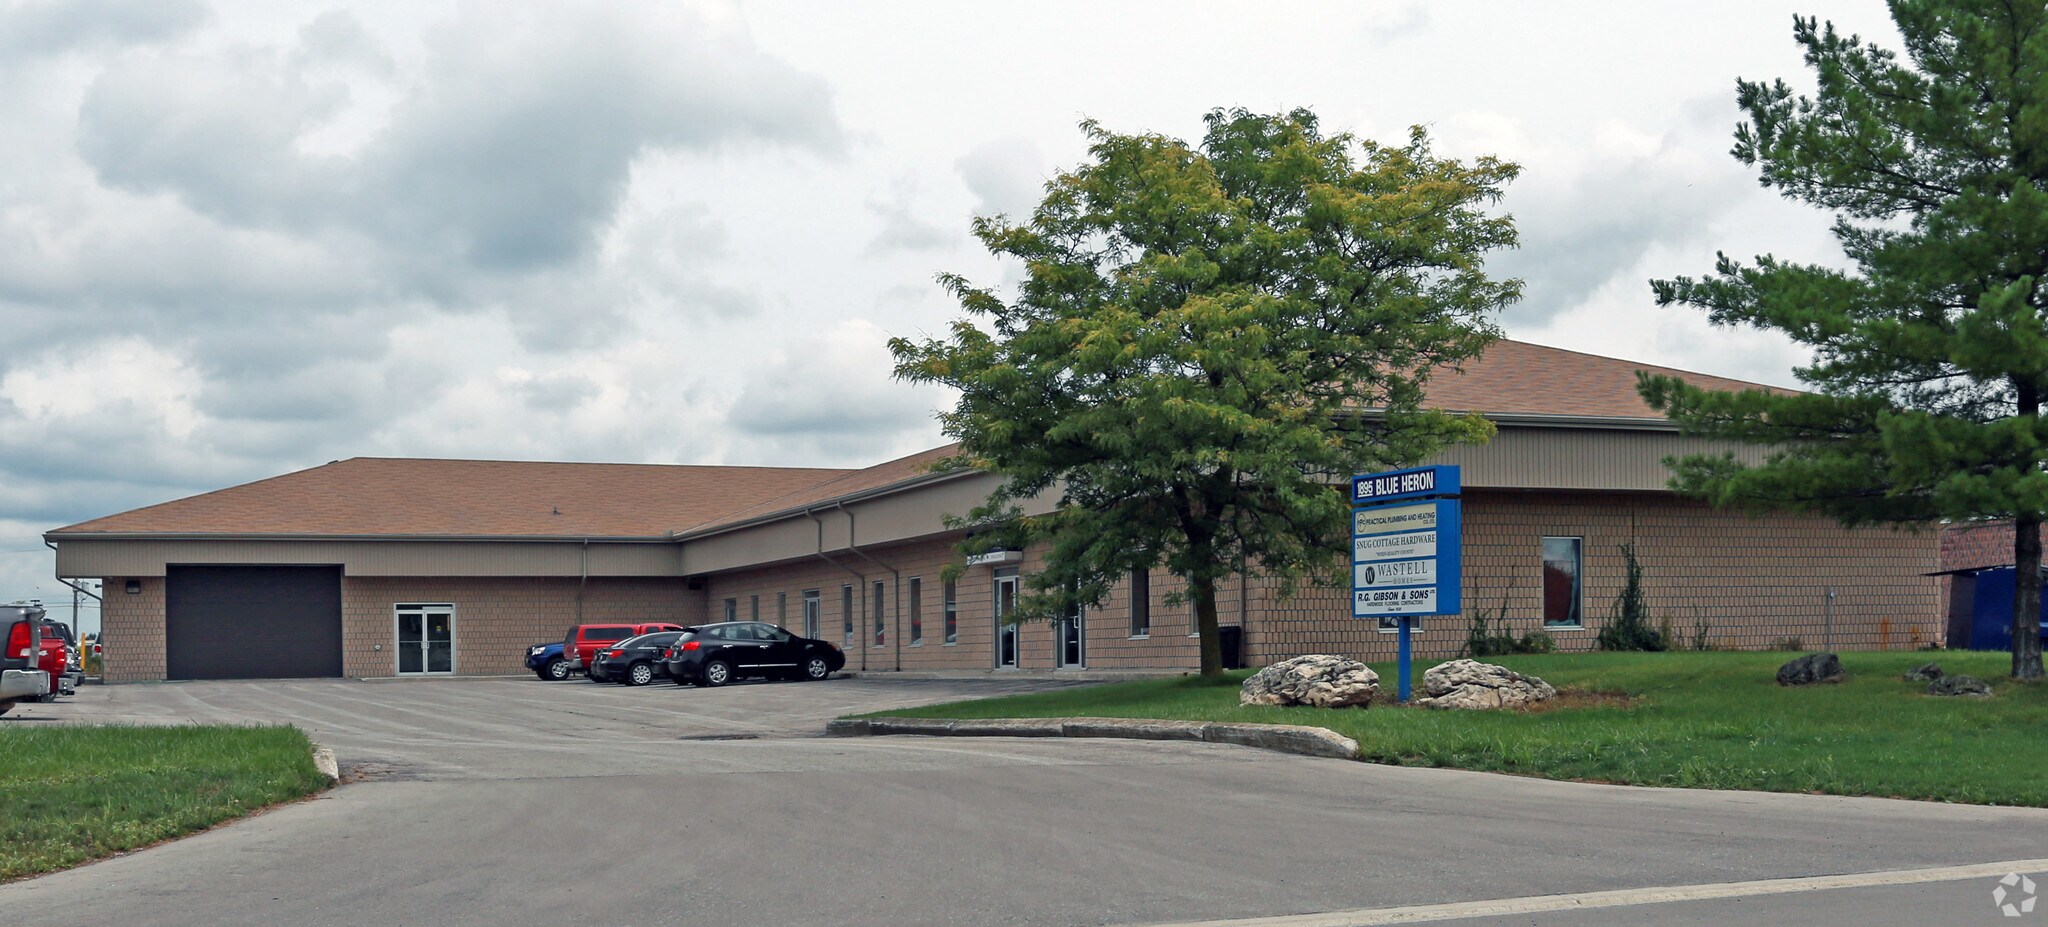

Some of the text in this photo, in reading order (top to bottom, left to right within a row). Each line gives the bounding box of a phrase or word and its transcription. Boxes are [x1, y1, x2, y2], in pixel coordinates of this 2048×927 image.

[1357, 472, 1434, 496] 1895 BLUE HERON
[1366, 517, 1387, 525] PRACTICAL
[1387, 515, 1407, 523] PLUMBING
[1417, 512, 1435, 520] HEATING
[1356, 534, 1436, 549] SNUG COTTAGE HARDWARE
[1377, 562, 1428, 576] WASTELL
[1357, 593, 1371, 602] R.G.
[1373, 592, 1399, 601] GIBSON
[1401, 591, 1406, 600] &
[1409, 590, 1429, 599] SONS
